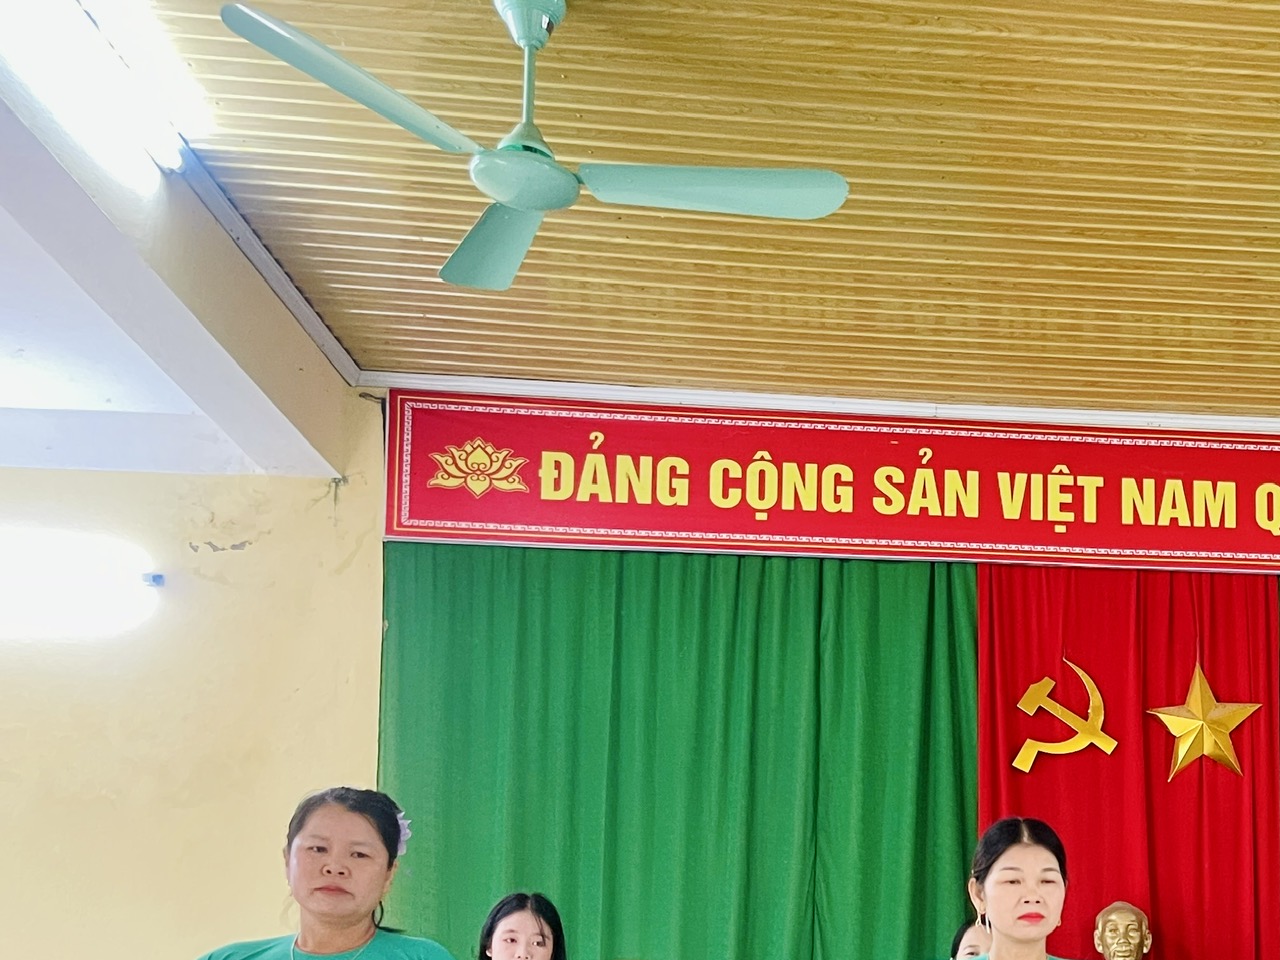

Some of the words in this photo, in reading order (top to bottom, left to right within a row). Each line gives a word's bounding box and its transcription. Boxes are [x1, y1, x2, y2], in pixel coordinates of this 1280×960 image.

[538, 431, 690, 506] ĐẢNG
[709, 450, 854, 521] CỘNG
[872, 447, 979, 518] SẢN
[997, 464, 1104, 533] VIỆT
[1121, 477, 1237, 529] NAM
